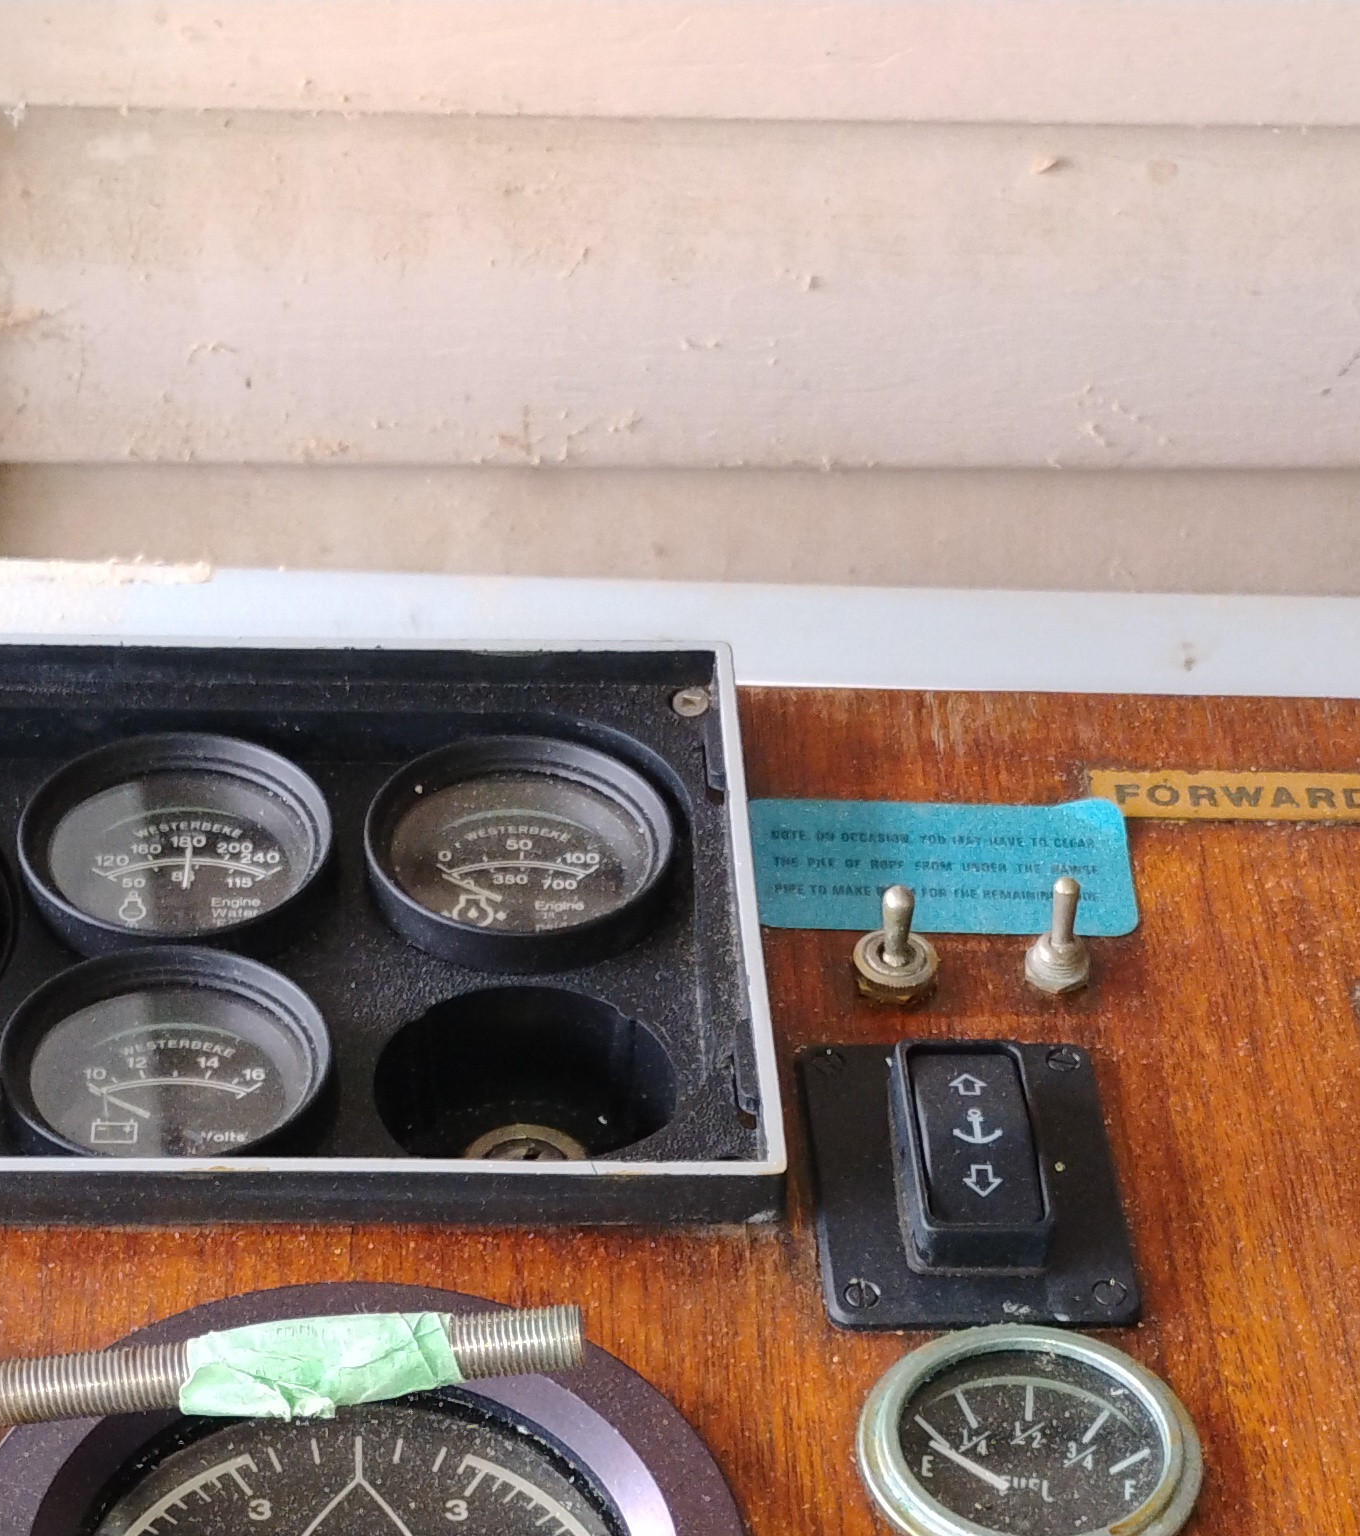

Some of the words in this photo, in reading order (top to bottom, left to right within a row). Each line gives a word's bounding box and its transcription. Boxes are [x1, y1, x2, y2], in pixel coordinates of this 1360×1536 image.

[170, 835, 207, 848] 180
[216, 842, 253, 854] 200
[505, 839, 533, 851] 50
[95, 854, 130, 867] 120
[240, 851, 280, 864] 240
[564, 852, 600, 864] 100
[122, 877, 146, 889] 50
[127, 1057, 149, 1070] 12
[197, 1056, 220, 1069] 14
[242, 1067, 266, 1081] 16
[921, 1456, 934, 1478] E
[1124, 1479, 1138, 1501] F
[248, 1499, 272, 1521] 3
[445, 1499, 470, 1522] 3
